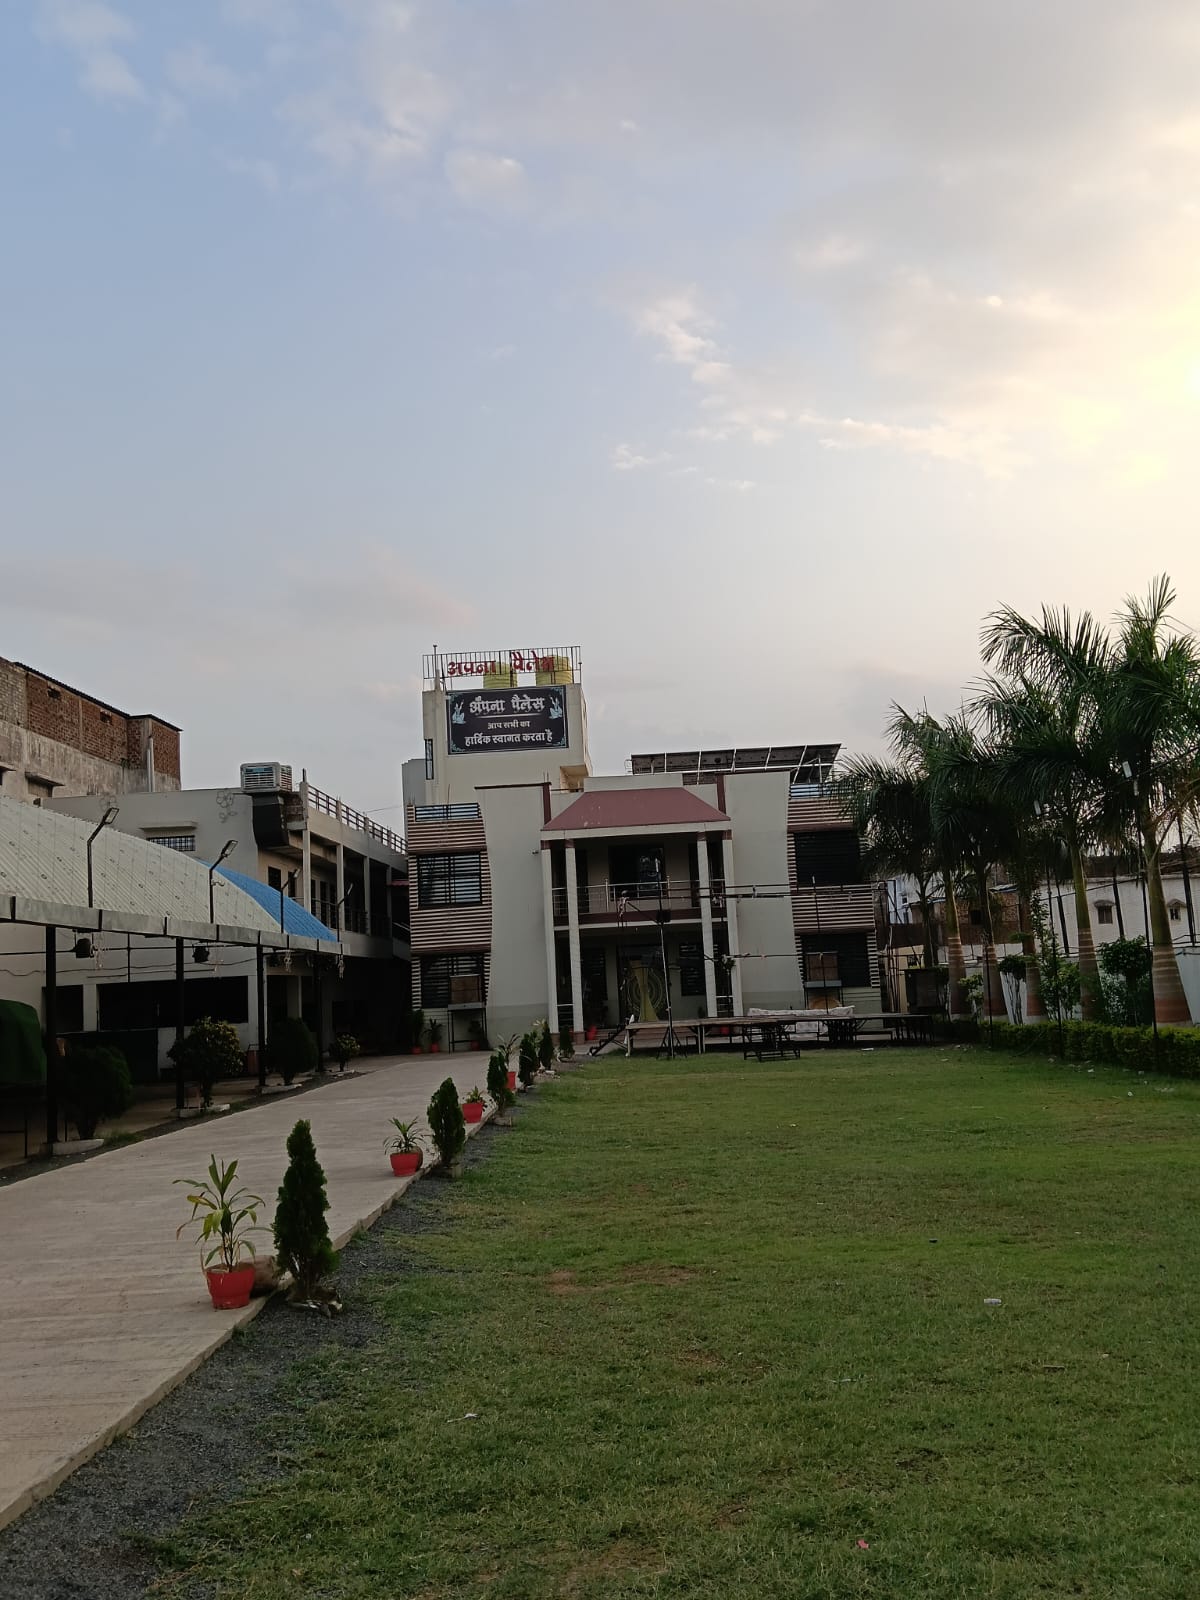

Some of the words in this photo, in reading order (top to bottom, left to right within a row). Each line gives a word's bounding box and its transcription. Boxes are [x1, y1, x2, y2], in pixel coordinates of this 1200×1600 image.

[447, 660, 497, 676] अपना
[511, 694, 545, 712] पैलेस
[487, 722, 502, 730] आप
[520, 720, 530, 728] का
[464, 732, 491, 747] हार्दिक
[492, 733, 521, 744] स्वागत
[522, 732, 545, 742] करता
[545, 729, 553, 742] है
